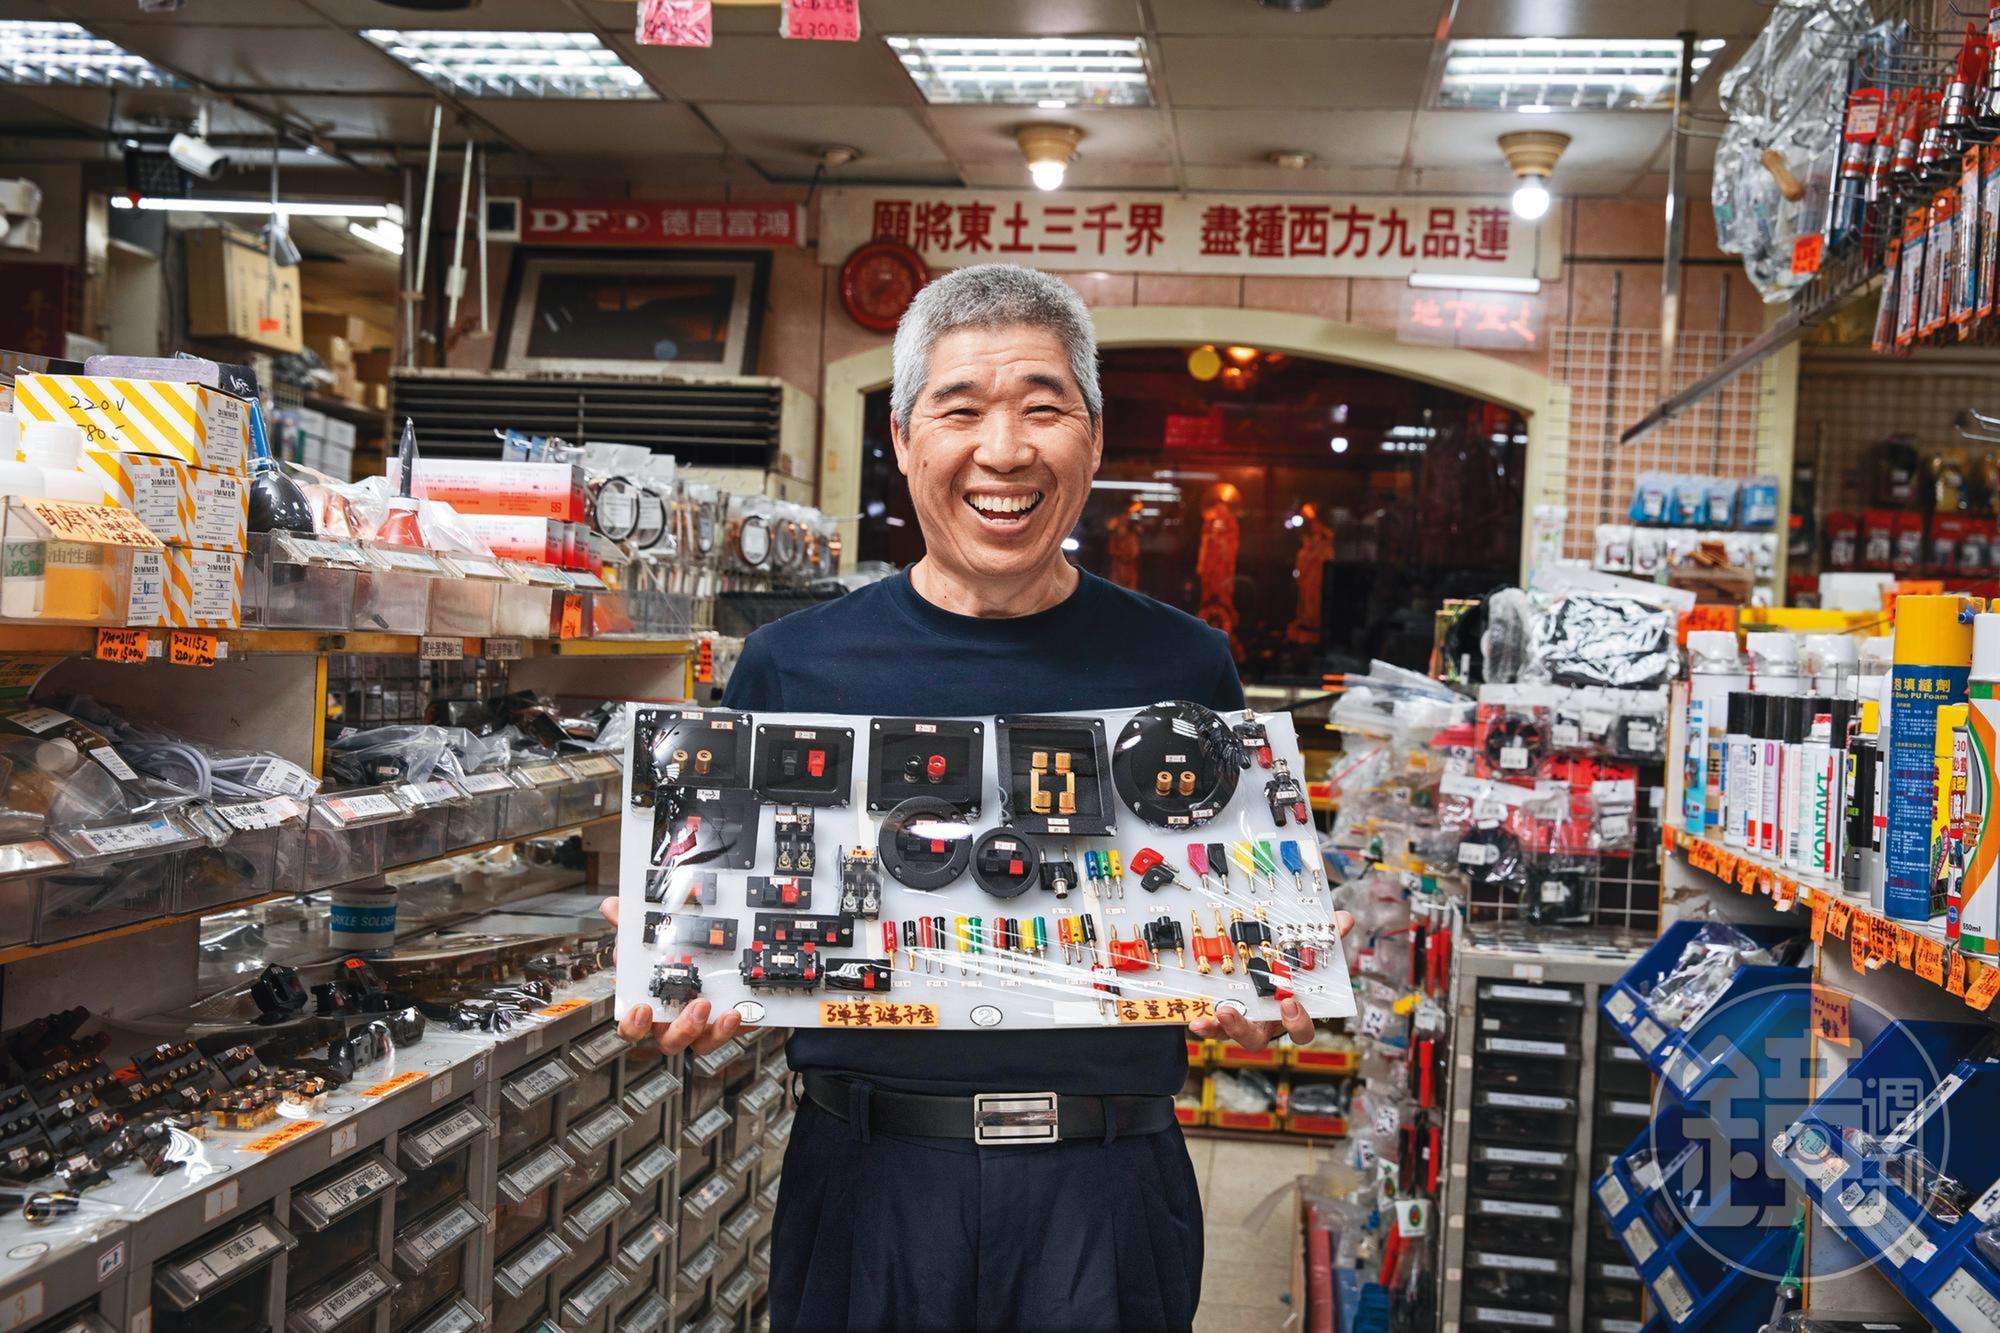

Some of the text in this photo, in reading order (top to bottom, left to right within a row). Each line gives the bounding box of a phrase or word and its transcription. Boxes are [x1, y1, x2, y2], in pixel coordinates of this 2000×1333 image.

[662, 208, 791, 237] 德昌富鴻
[872, 200, 1511, 262] 願將東土三千界 盡種西方九品蓮
[1814, 772, 1828, 868] KONTAKT
[1963, 922, 1982, 933] 550ml
